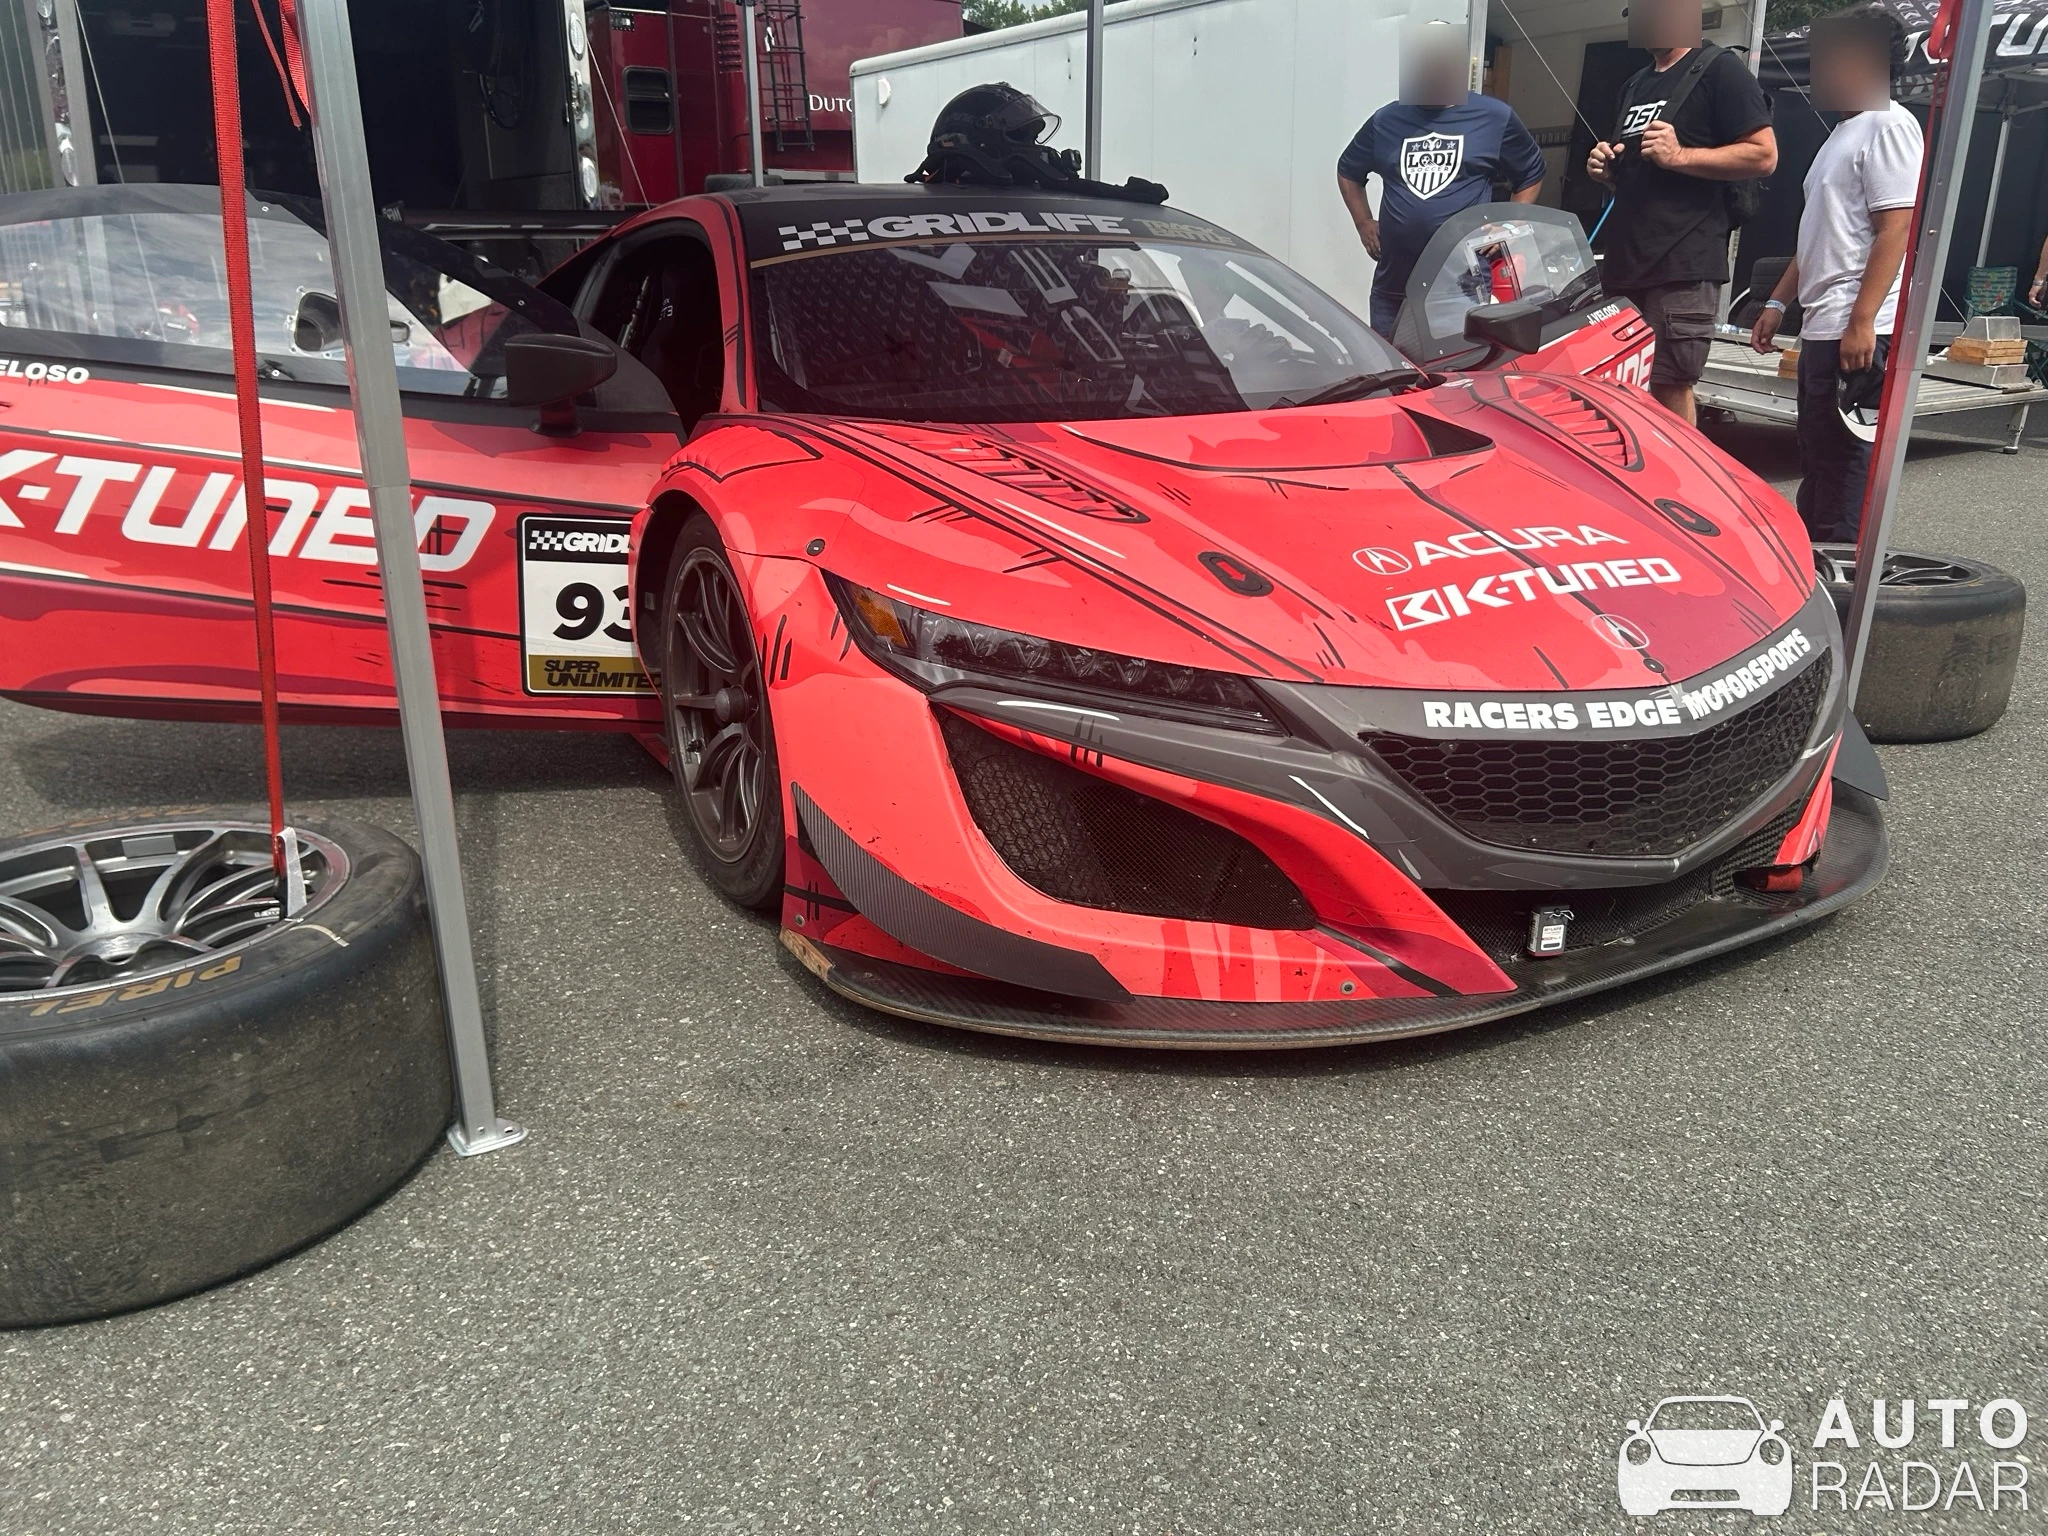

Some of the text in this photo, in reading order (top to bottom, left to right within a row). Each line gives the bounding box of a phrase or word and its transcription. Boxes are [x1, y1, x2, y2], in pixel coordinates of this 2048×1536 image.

[1408, 152, 1453, 168] LODI
[867, 211, 1130, 239] GRIDLIFE
[1131, 218, 1214, 234] TRACK
[1586, 304, 1620, 326] J.VELOSO
[1414, 525, 1630, 566] ACURA
[1443, 557, 1681, 617] K-TUNED
[553, 582, 635, 643] 93
[544, 660, 600, 673] SUPER
[1423, 628, 1811, 730] RACERS EDGE MOTORSPORTS
